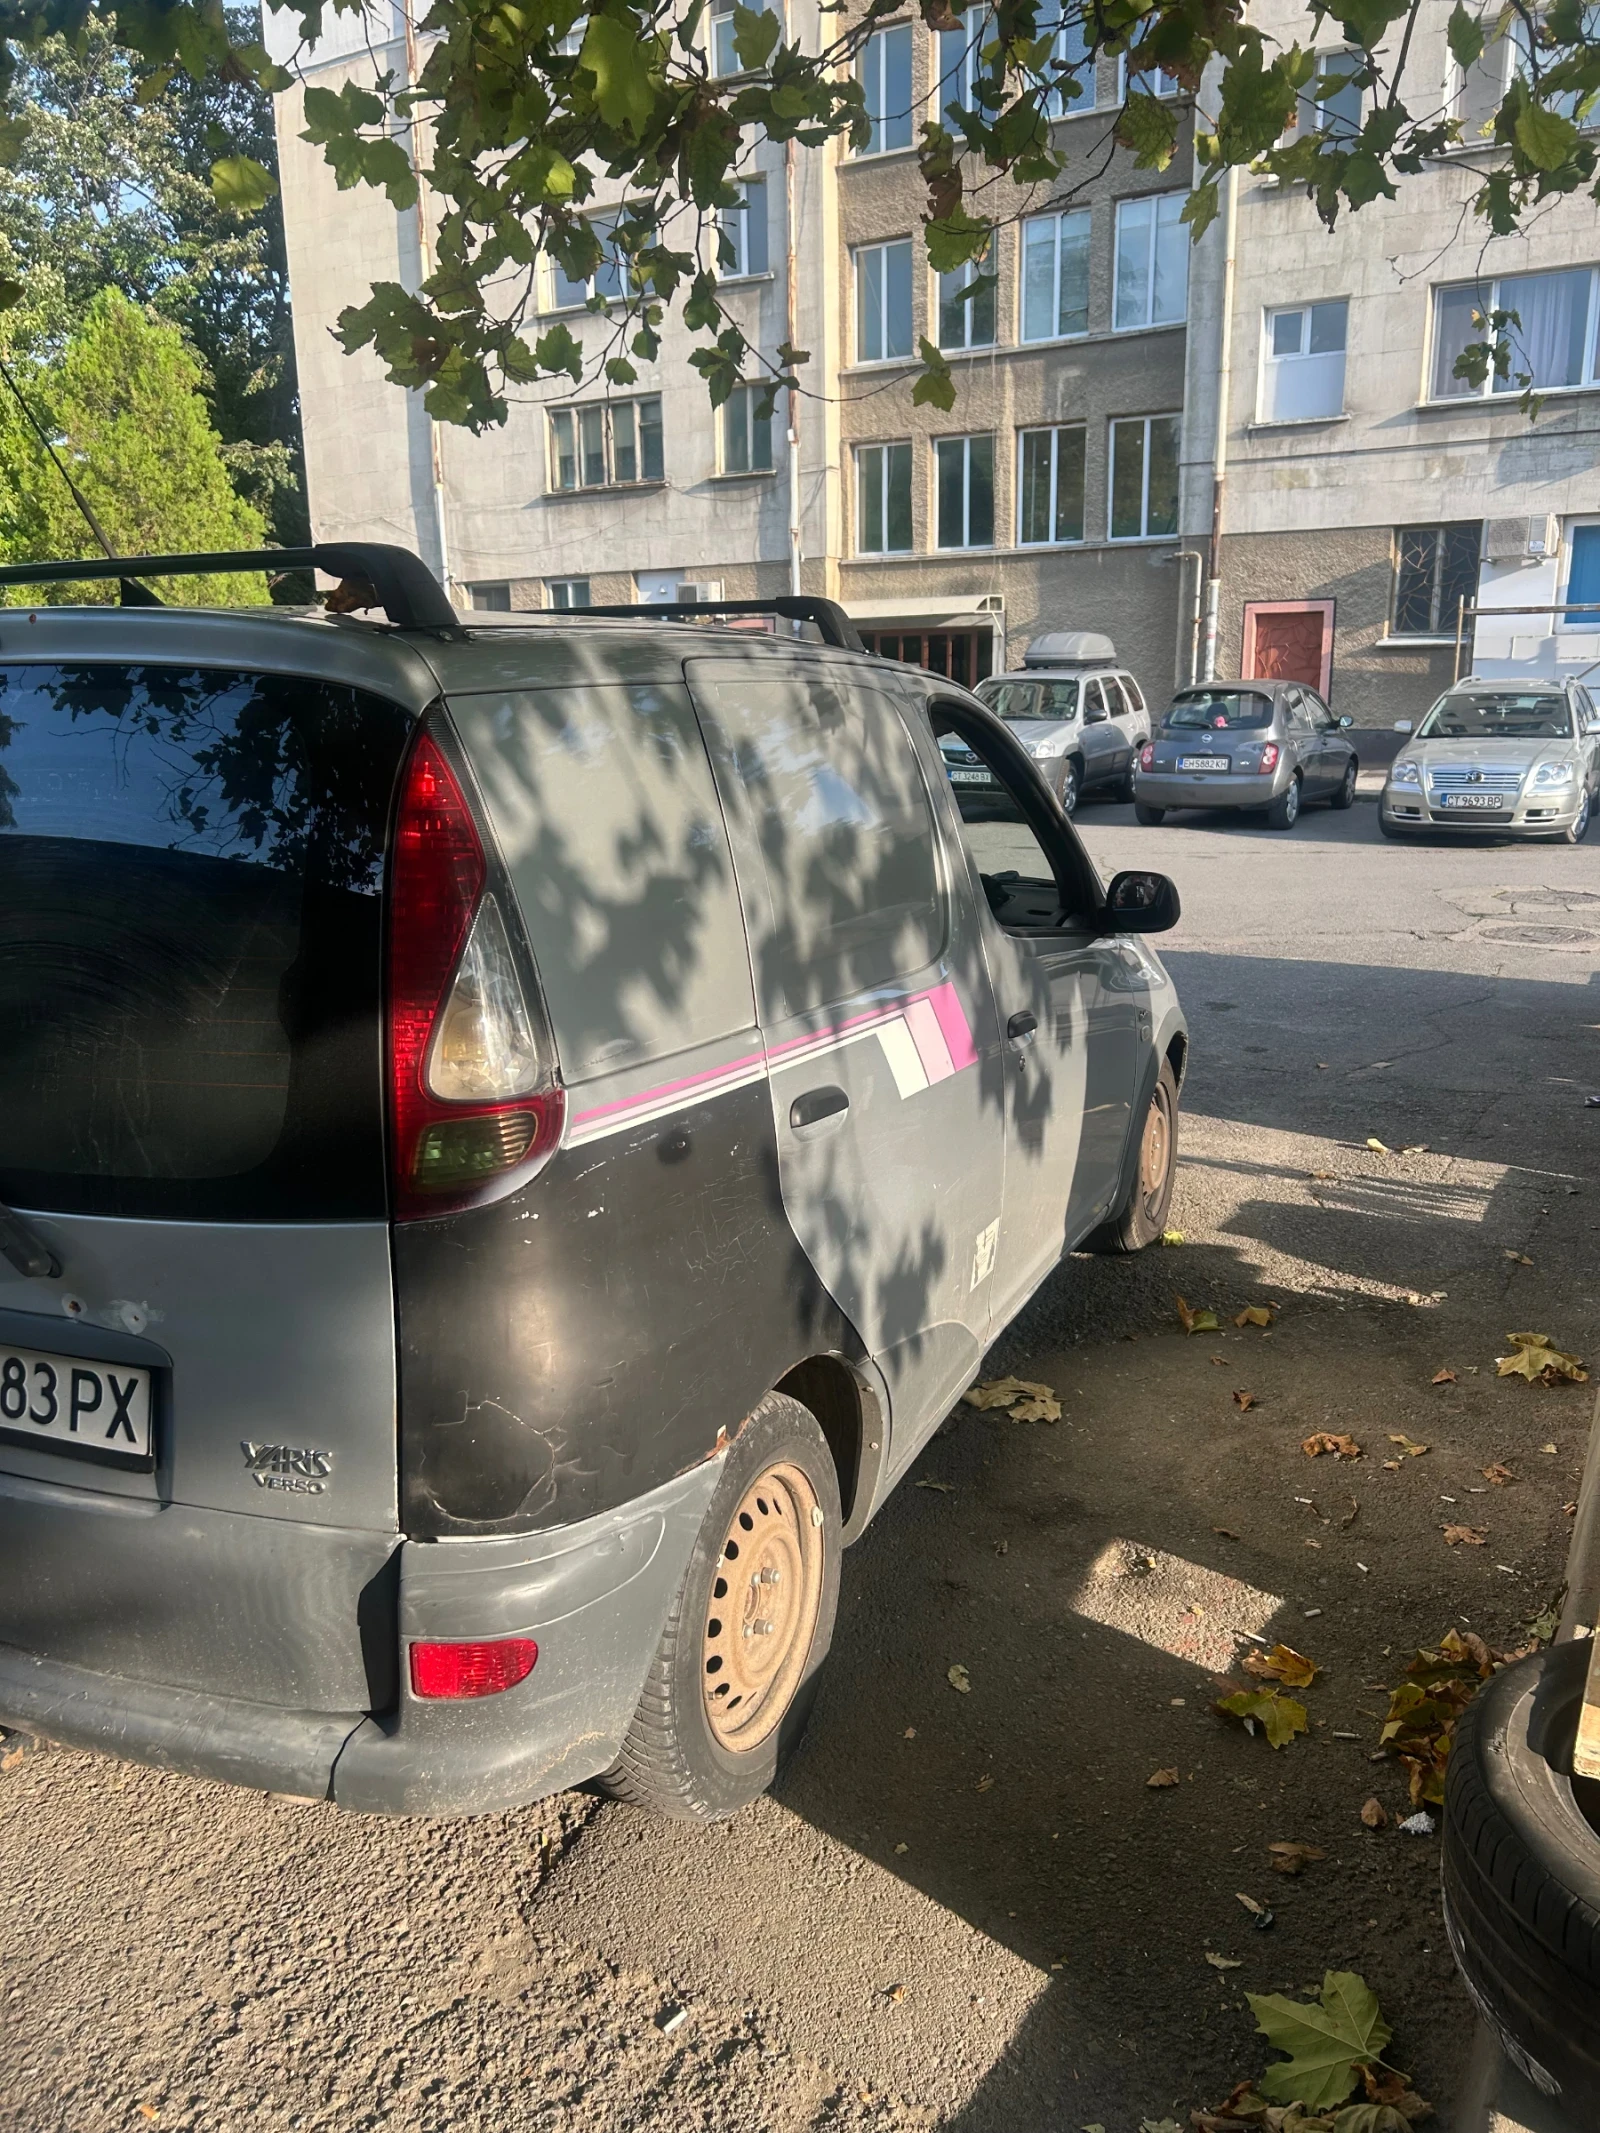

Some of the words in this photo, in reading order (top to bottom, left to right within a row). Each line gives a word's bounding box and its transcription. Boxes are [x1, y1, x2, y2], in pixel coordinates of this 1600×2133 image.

[1183, 759, 1195, 768] EH
[1195, 759, 1215, 768] 5882
[1215, 760, 1227, 769] KH
[1447, 795, 1460, 806] CT
[1462, 796, 1486, 806] 9693
[1487, 796, 1501, 806] BP
[0, 1357, 59, 1425] 83
[70, 1368, 140, 1444] PX
[252, 1472, 326, 1495] VERSO
